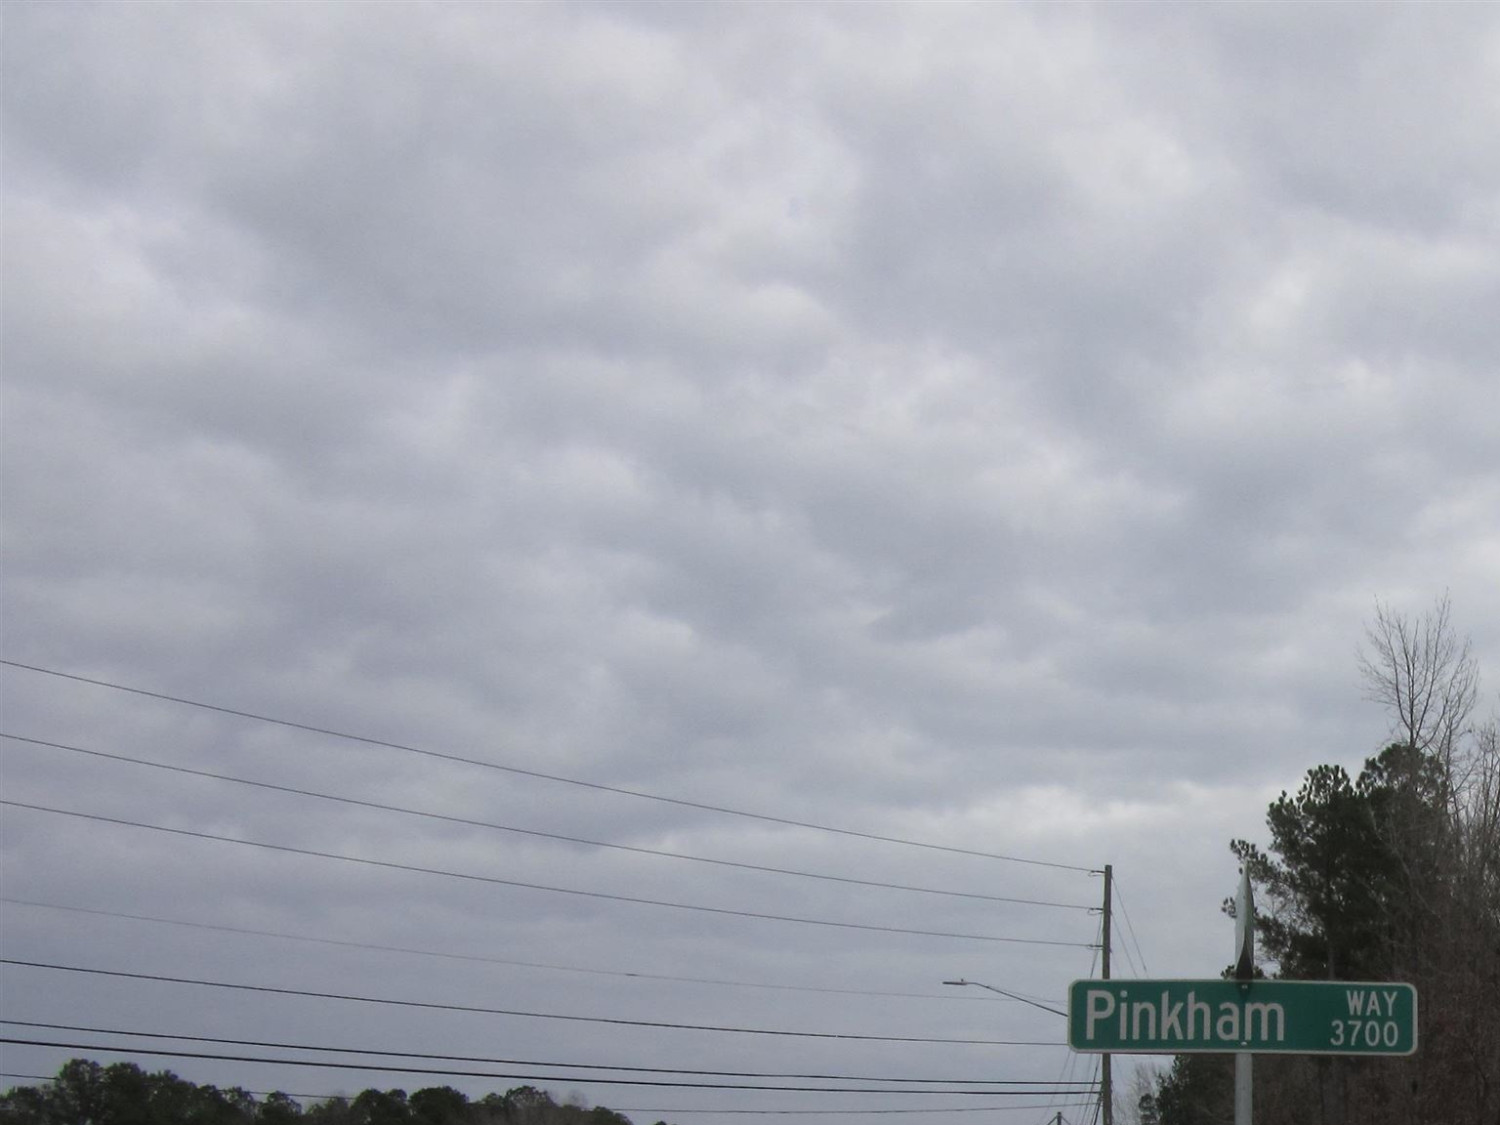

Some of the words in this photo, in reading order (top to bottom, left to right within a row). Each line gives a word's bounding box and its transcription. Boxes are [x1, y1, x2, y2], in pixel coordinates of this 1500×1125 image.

[1085, 989, 1286, 1042] Pinkham
[1346, 989, 1398, 1017] WAY
[1330, 1020, 1399, 1047] 3700
